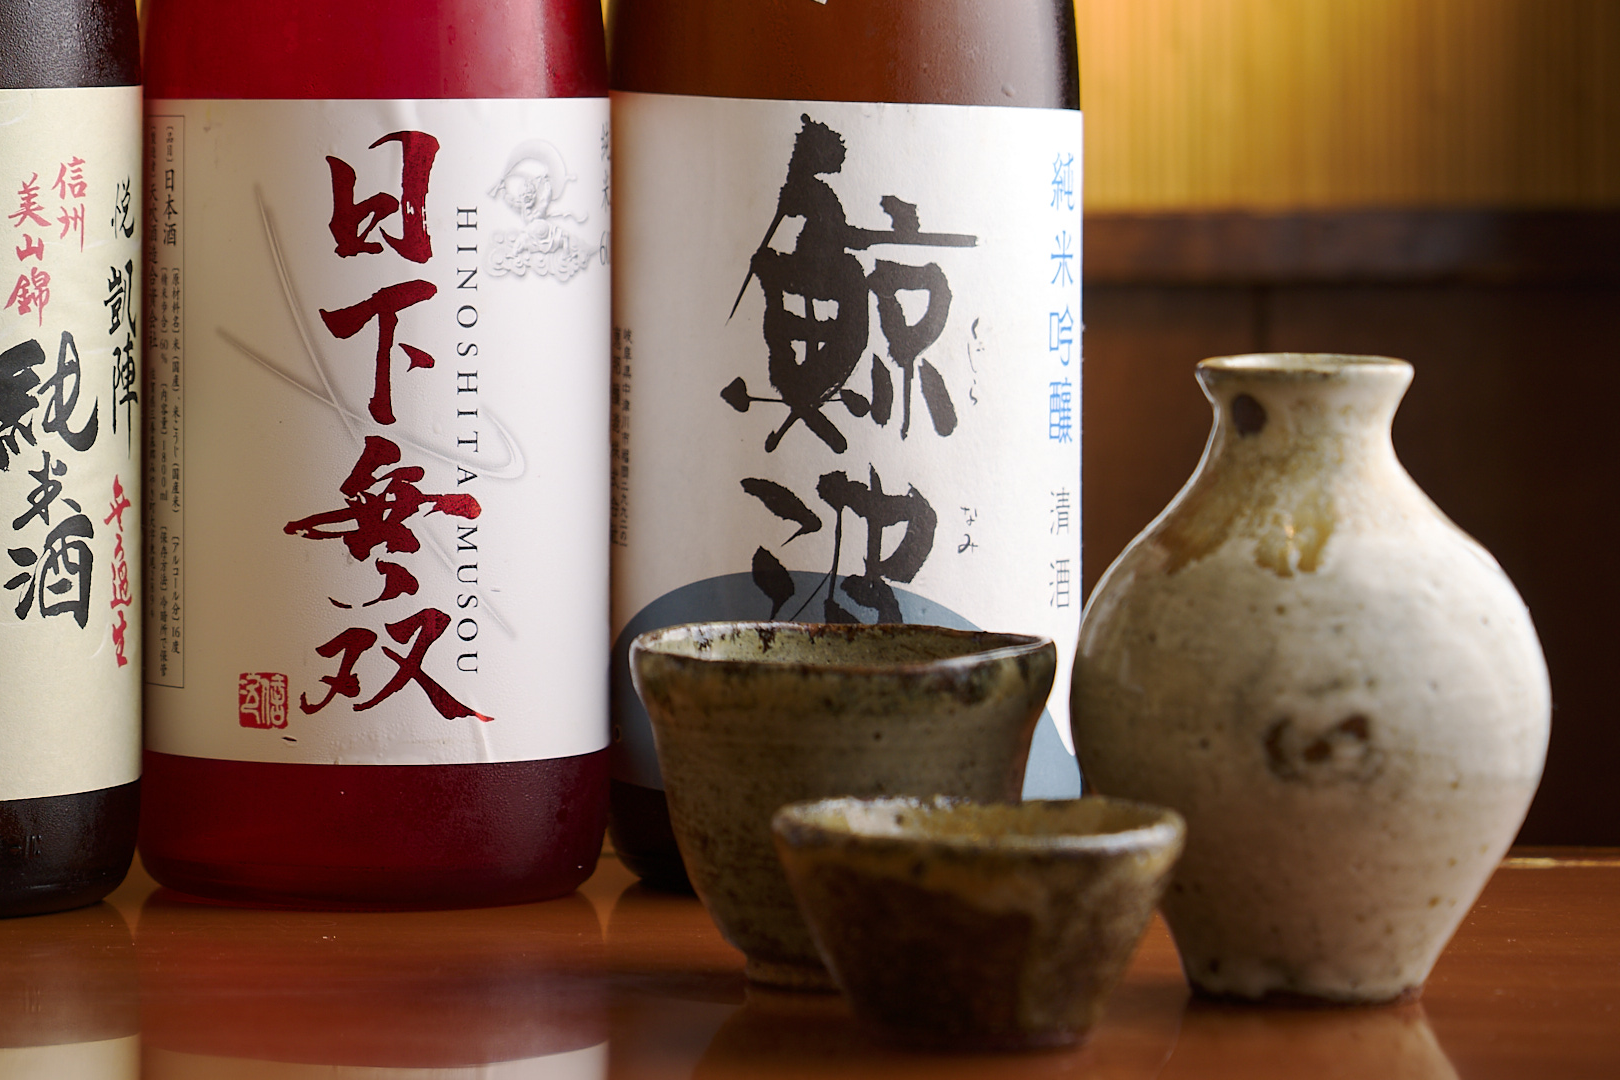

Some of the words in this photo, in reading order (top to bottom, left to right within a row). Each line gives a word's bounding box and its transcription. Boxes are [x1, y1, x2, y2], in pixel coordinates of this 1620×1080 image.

[3, 172, 52, 328] 美山錦
[51, 156, 88, 254] 信州
[455, 205, 479, 489] HINOSHITA
[1048, 151, 1076, 445] 純米吟醸
[282, 129, 495, 722] 日下無双
[455, 524, 479, 676] MUSOU
[1048, 487, 1071, 610] 清酒
